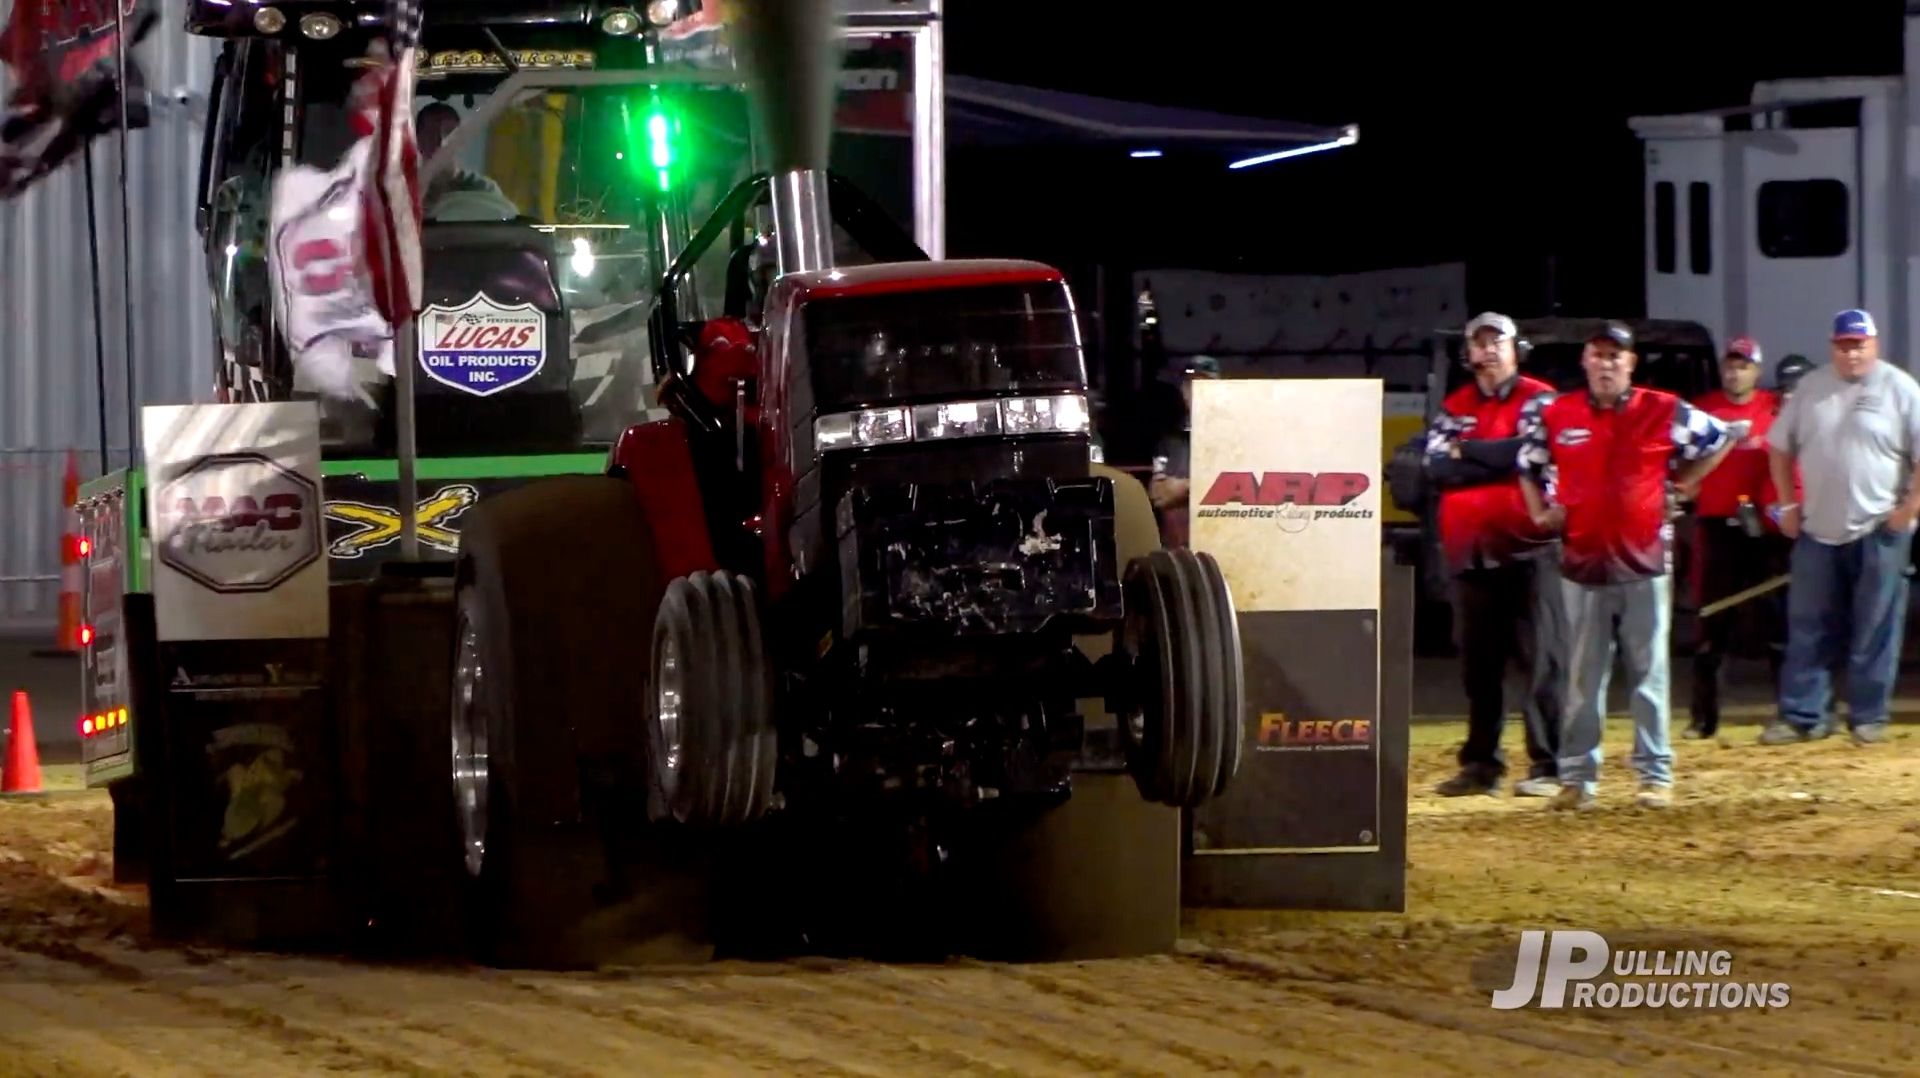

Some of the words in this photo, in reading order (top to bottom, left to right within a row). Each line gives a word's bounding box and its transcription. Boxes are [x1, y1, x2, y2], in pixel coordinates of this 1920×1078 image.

[435, 325, 536, 349] LUCAS
[428, 355, 454, 367] OIL
[458, 355, 537, 367] PRODUCTS
[468, 371, 499, 382] INC.
[1199, 472, 1370, 506] ARP
[1197, 507, 1275, 518] automotive
[1313, 508, 1373, 520] products
[1259, 712, 1371, 744] FLEECE
